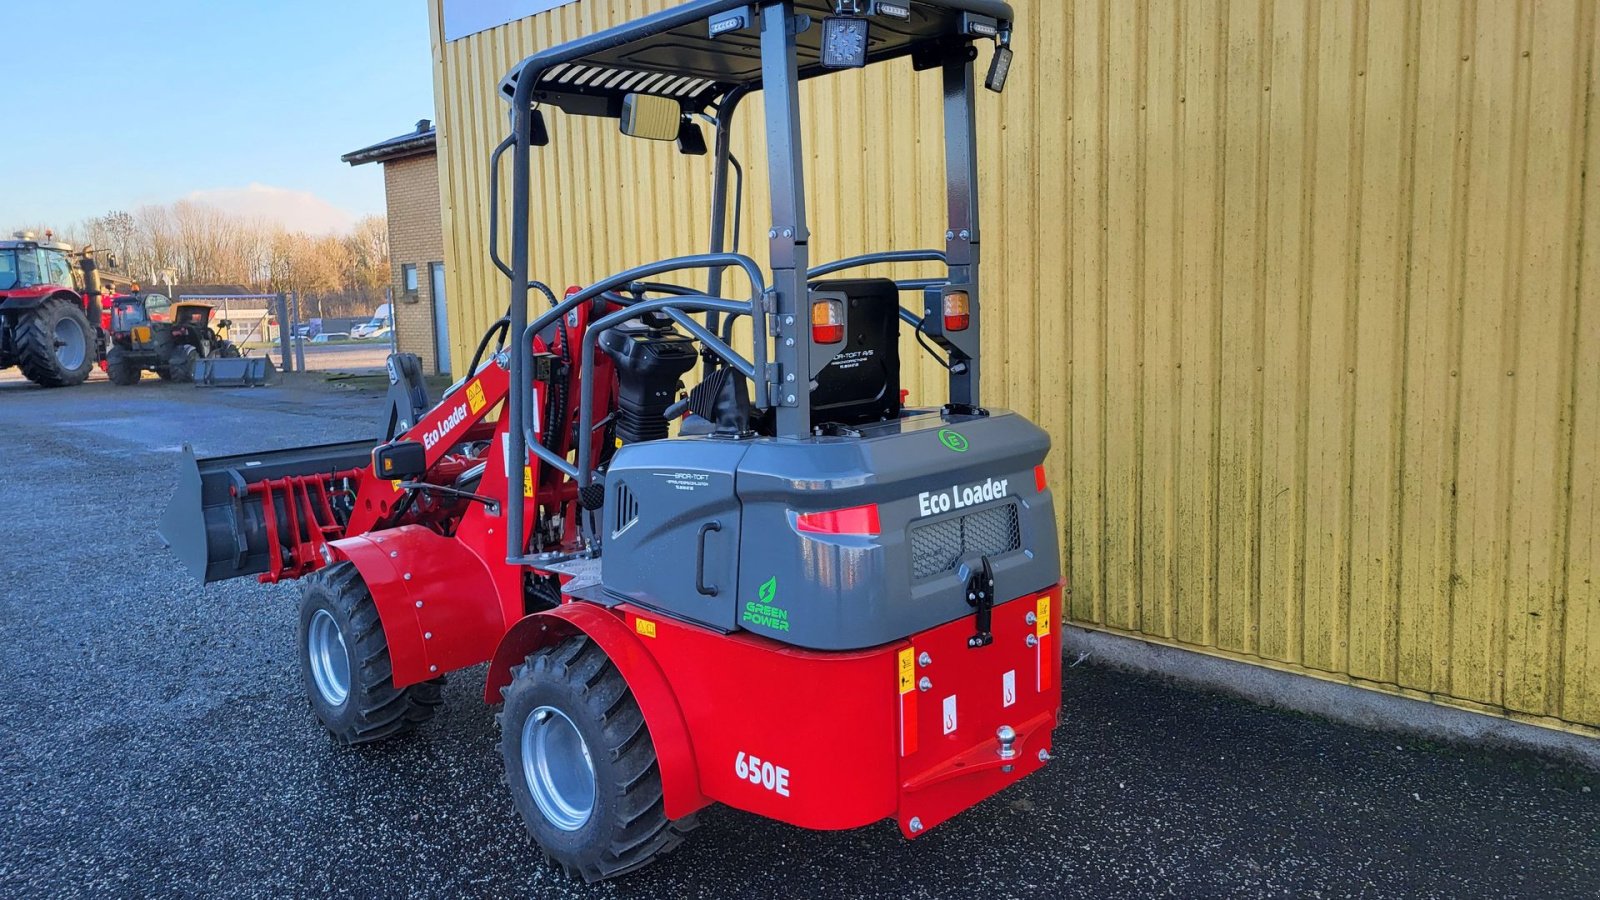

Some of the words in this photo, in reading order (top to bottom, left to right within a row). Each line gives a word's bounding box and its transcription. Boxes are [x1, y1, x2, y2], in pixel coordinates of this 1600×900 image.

[422, 429, 440, 451] Eco
[437, 402, 468, 438] Loader
[918, 491, 951, 517] Eco
[952, 478, 1008, 509] Loader
[743, 611, 790, 632] POWER
[746, 601, 788, 620] GREEN
[735, 751, 790, 798] 650E
